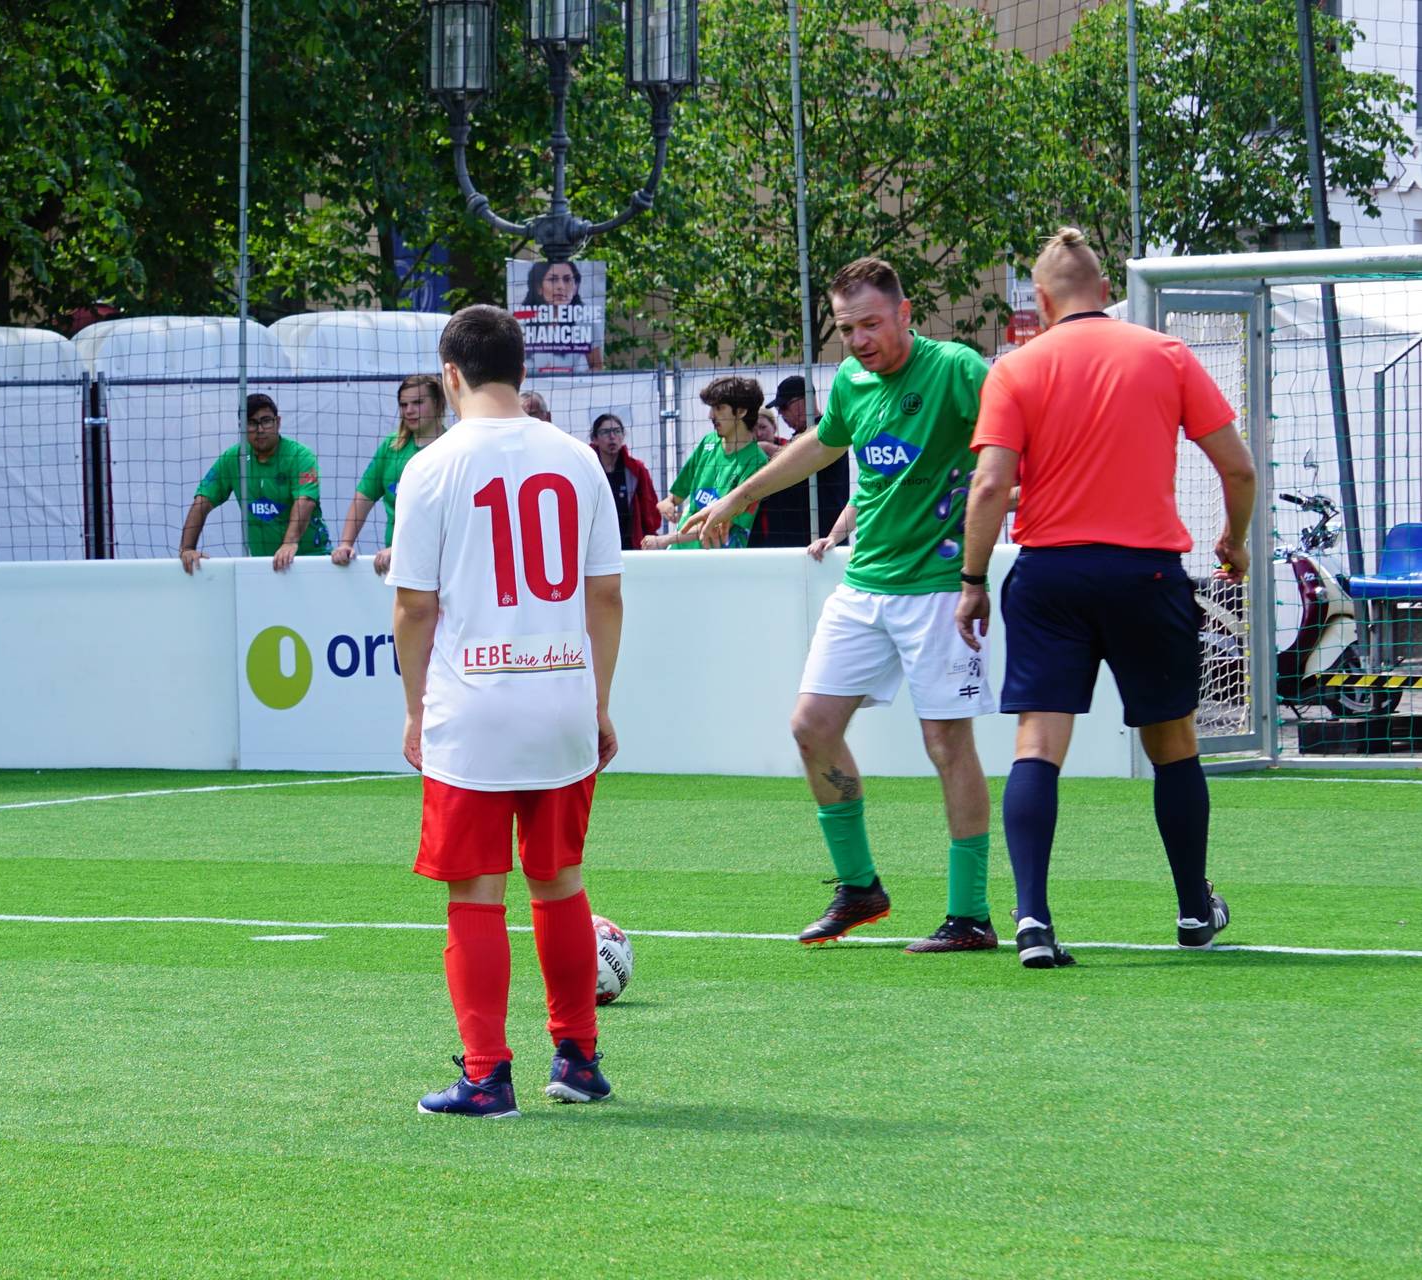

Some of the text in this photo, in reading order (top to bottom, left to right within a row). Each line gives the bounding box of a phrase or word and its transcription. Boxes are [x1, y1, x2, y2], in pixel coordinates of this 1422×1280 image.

[864, 446, 910, 465] IBSA
[251, 503, 279, 515] IBSA
[473, 472, 579, 607] 10
[464, 643, 513, 667] LEBE
[515, 654, 539, 667] wie
